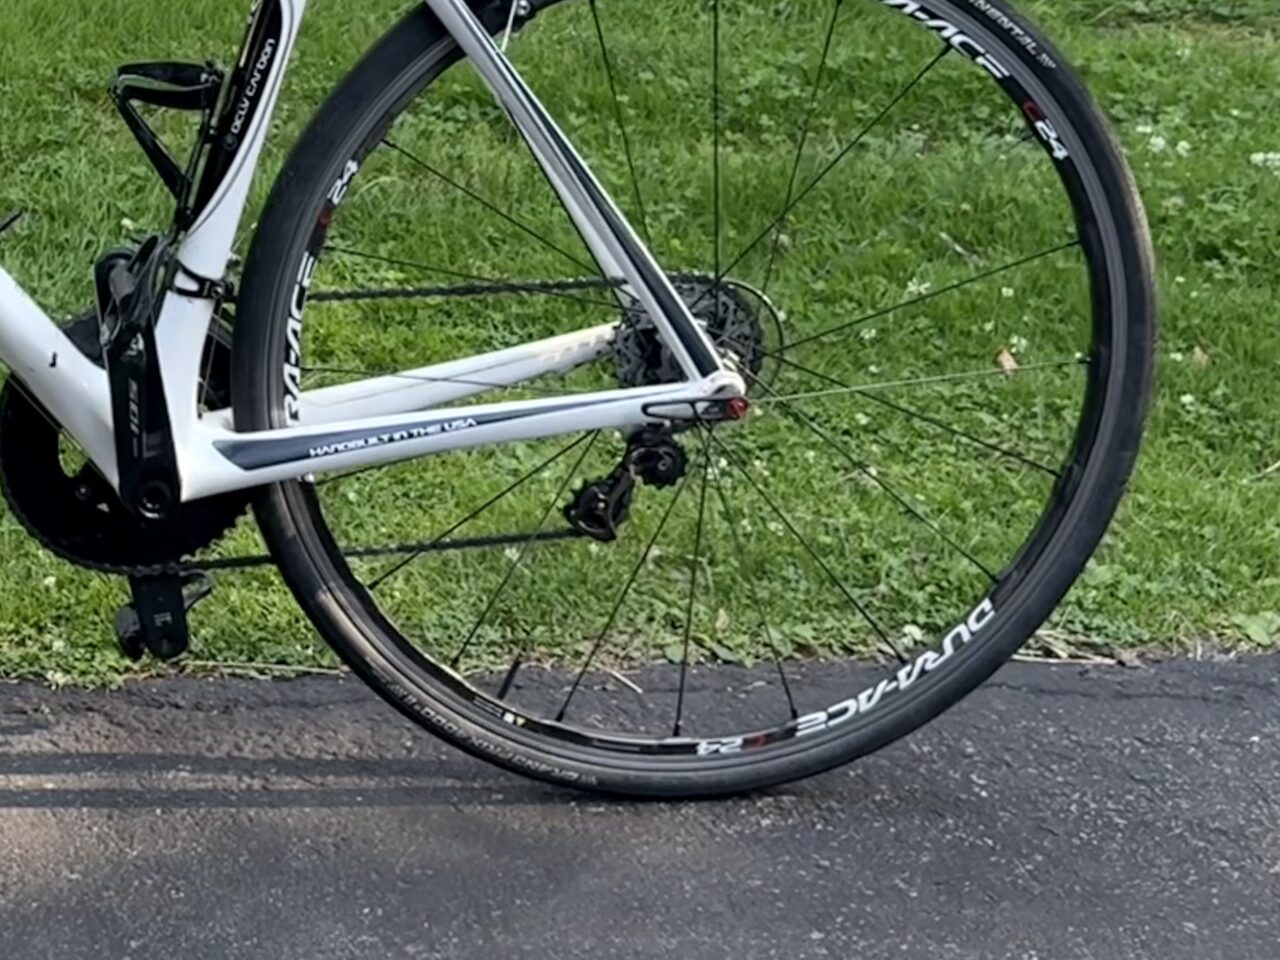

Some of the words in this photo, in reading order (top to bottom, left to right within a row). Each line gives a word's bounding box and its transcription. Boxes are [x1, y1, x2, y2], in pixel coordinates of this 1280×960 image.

[282, 251, 318, 426] RA-ACE
[443, 418, 477, 432] USA
[796, 598, 996, 738] DURA-ACE
